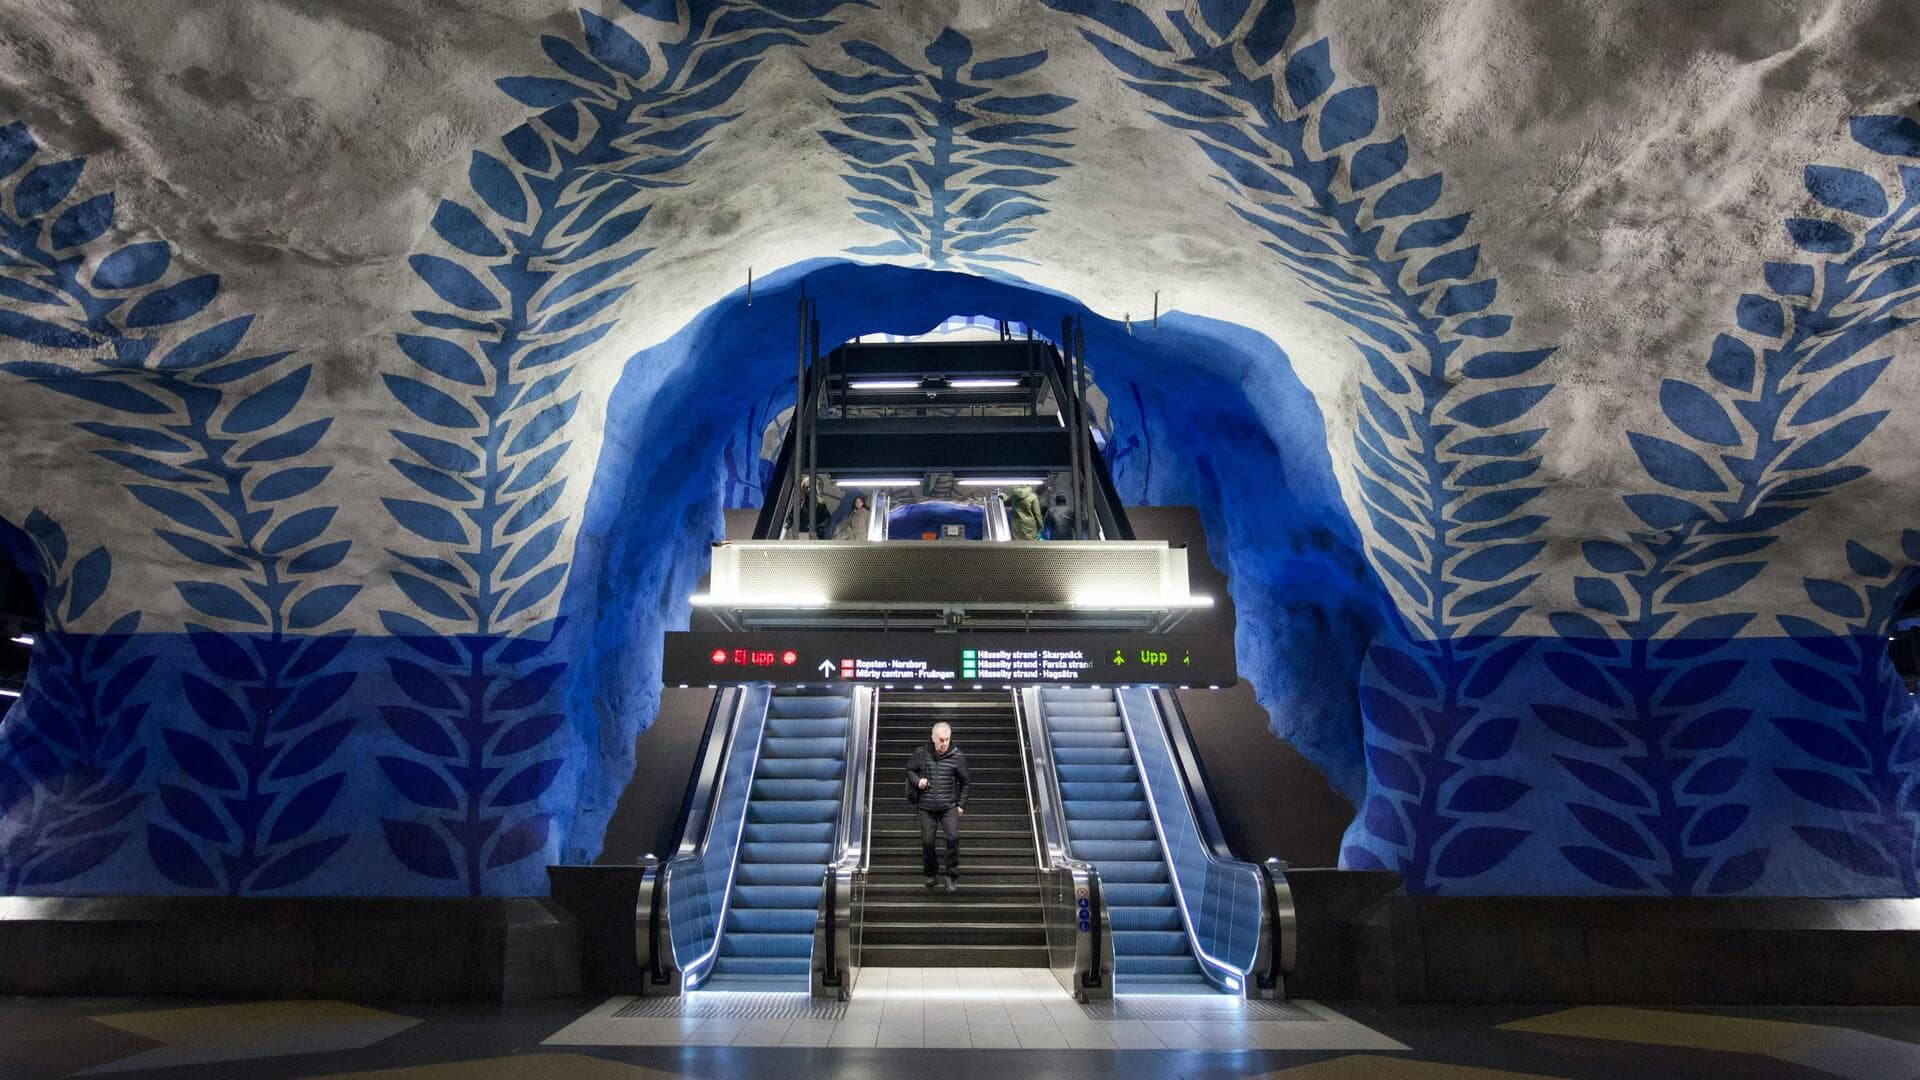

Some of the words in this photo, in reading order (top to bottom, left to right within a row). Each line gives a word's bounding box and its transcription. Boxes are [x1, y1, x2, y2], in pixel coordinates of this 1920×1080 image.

[751, 652, 775, 666] upp
[978, 650, 1011, 660] Hässelby
[1012, 650, 1038, 659] strand
[1042, 650, 1083, 660] Skarpnäck
[1140, 650, 1168, 666] Upp
[856, 660, 887, 670] Ropsten
[892, 660, 927, 670] Norsborg
[978, 660, 1012, 670] Hässelby
[1013, 660, 1038, 669] strand
[1042, 660, 1068, 669] Farsta
[1068, 660, 1093, 669] strand
[856, 669, 881, 679] Mörby
[881, 669, 914, 678] centrum
[918, 669, 955, 680] Fruängen
[978, 669, 1012, 679] Hässelby
[1013, 669, 1038, 678] strand
[1042, 669, 1078, 679] Hagsätra
